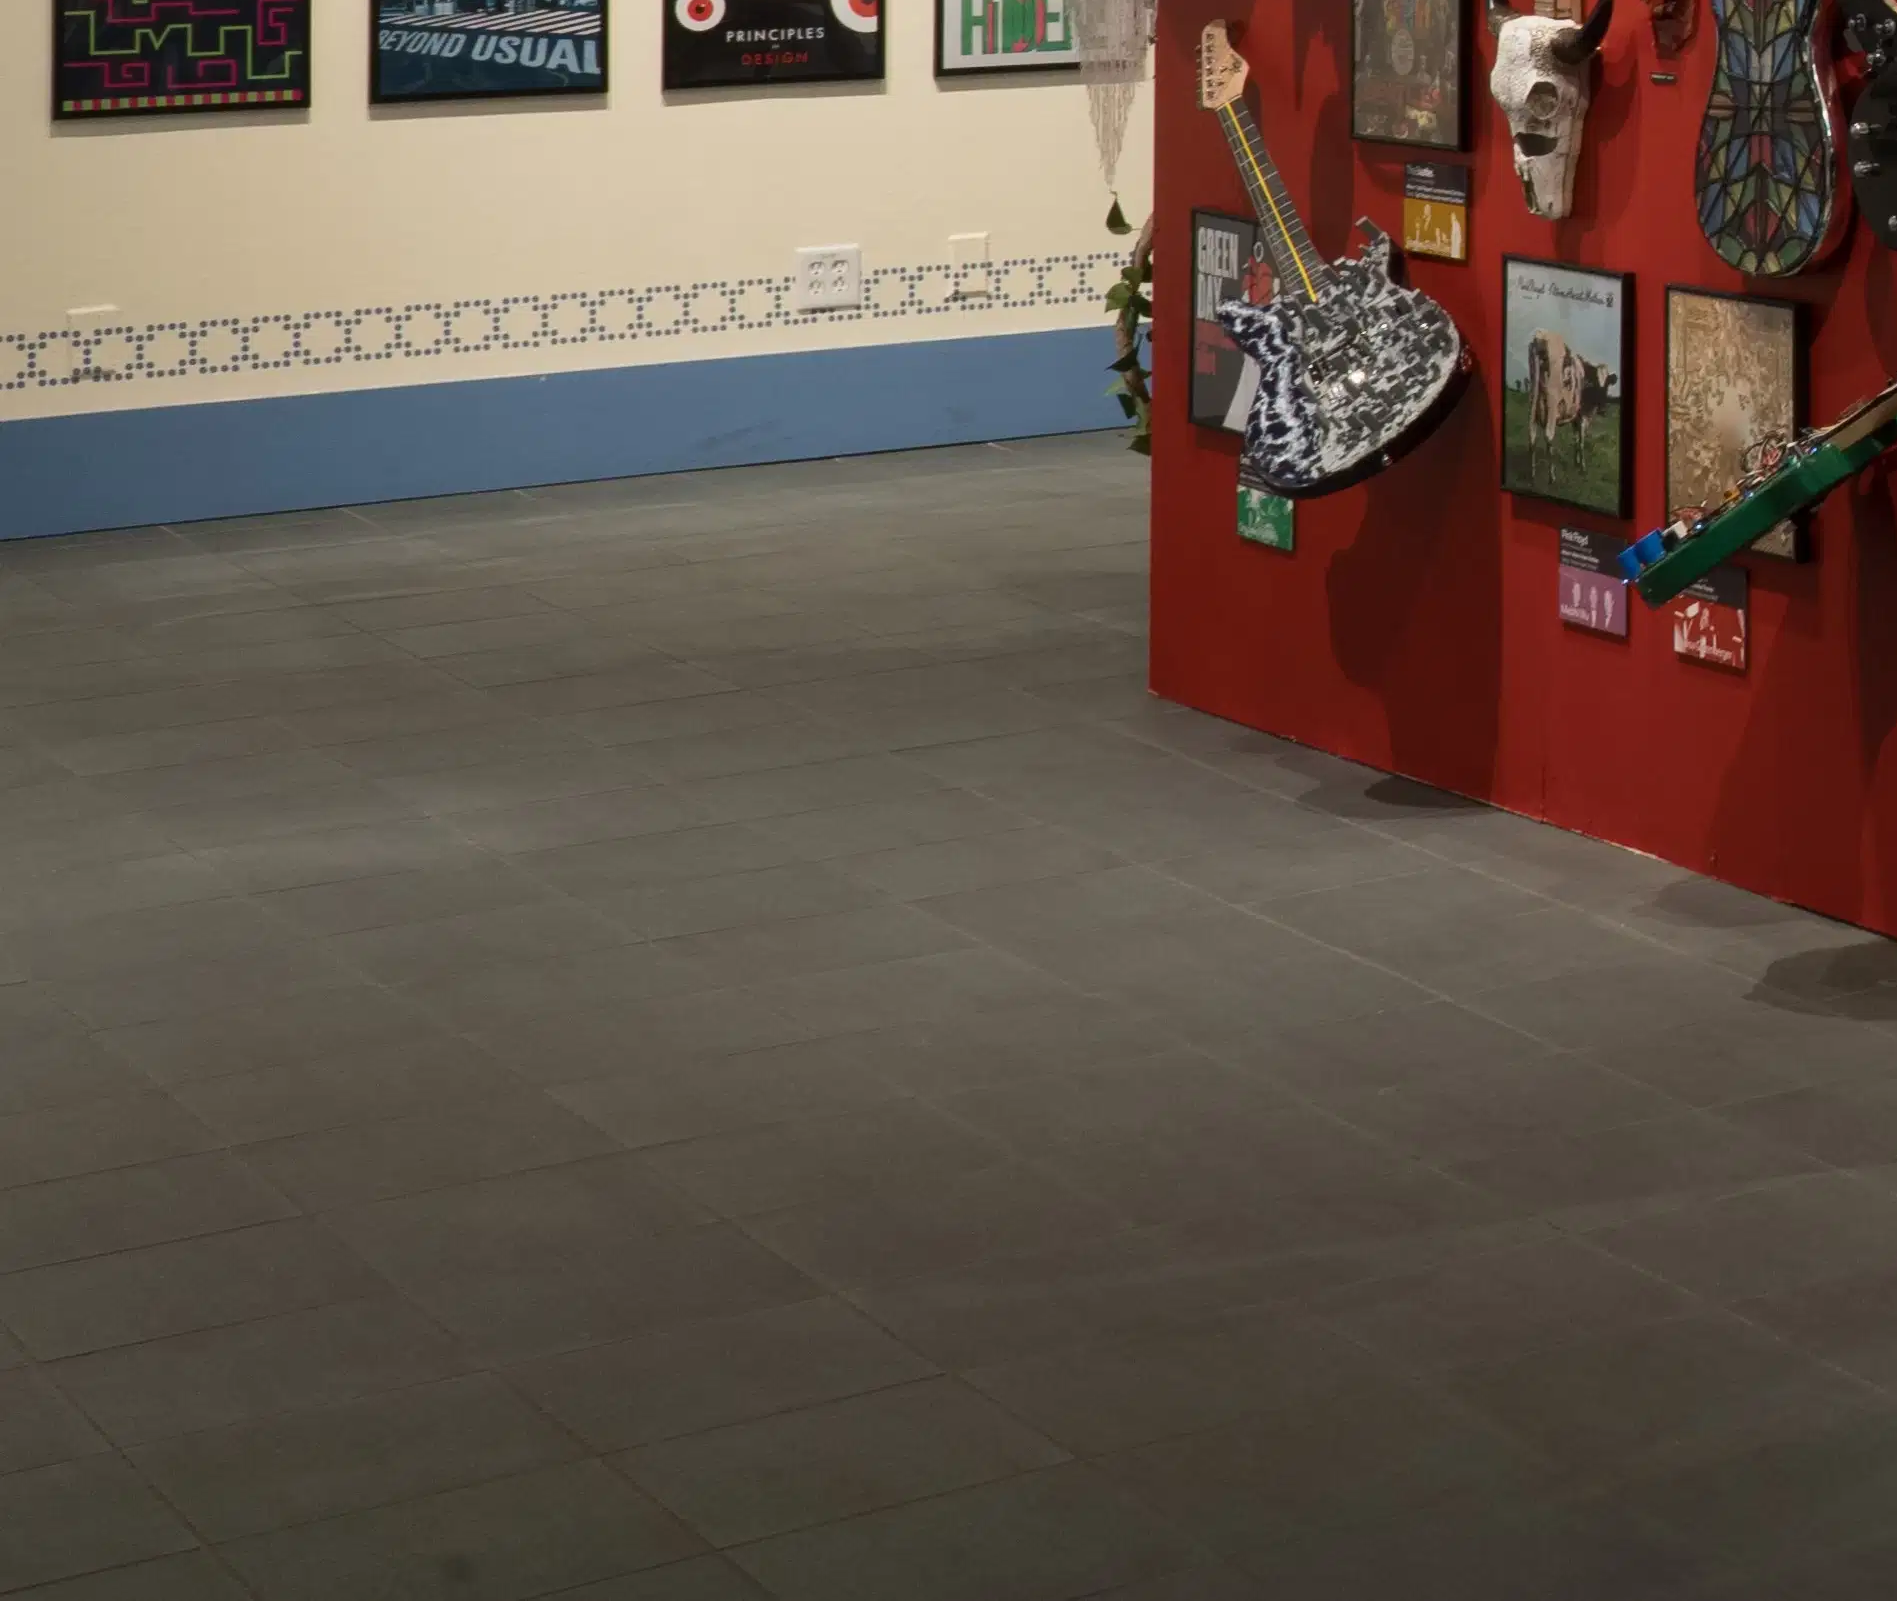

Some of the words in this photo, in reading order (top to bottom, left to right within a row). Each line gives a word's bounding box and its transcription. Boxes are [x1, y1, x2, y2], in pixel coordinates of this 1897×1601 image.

[725, 27, 825, 42] PRINCIPLES
[379, 29, 467, 58] BEYOND
[471, 33, 602, 75] USUAL
[741, 52, 809, 65] DESIGN
[1197, 227, 1240, 280] GREEN
